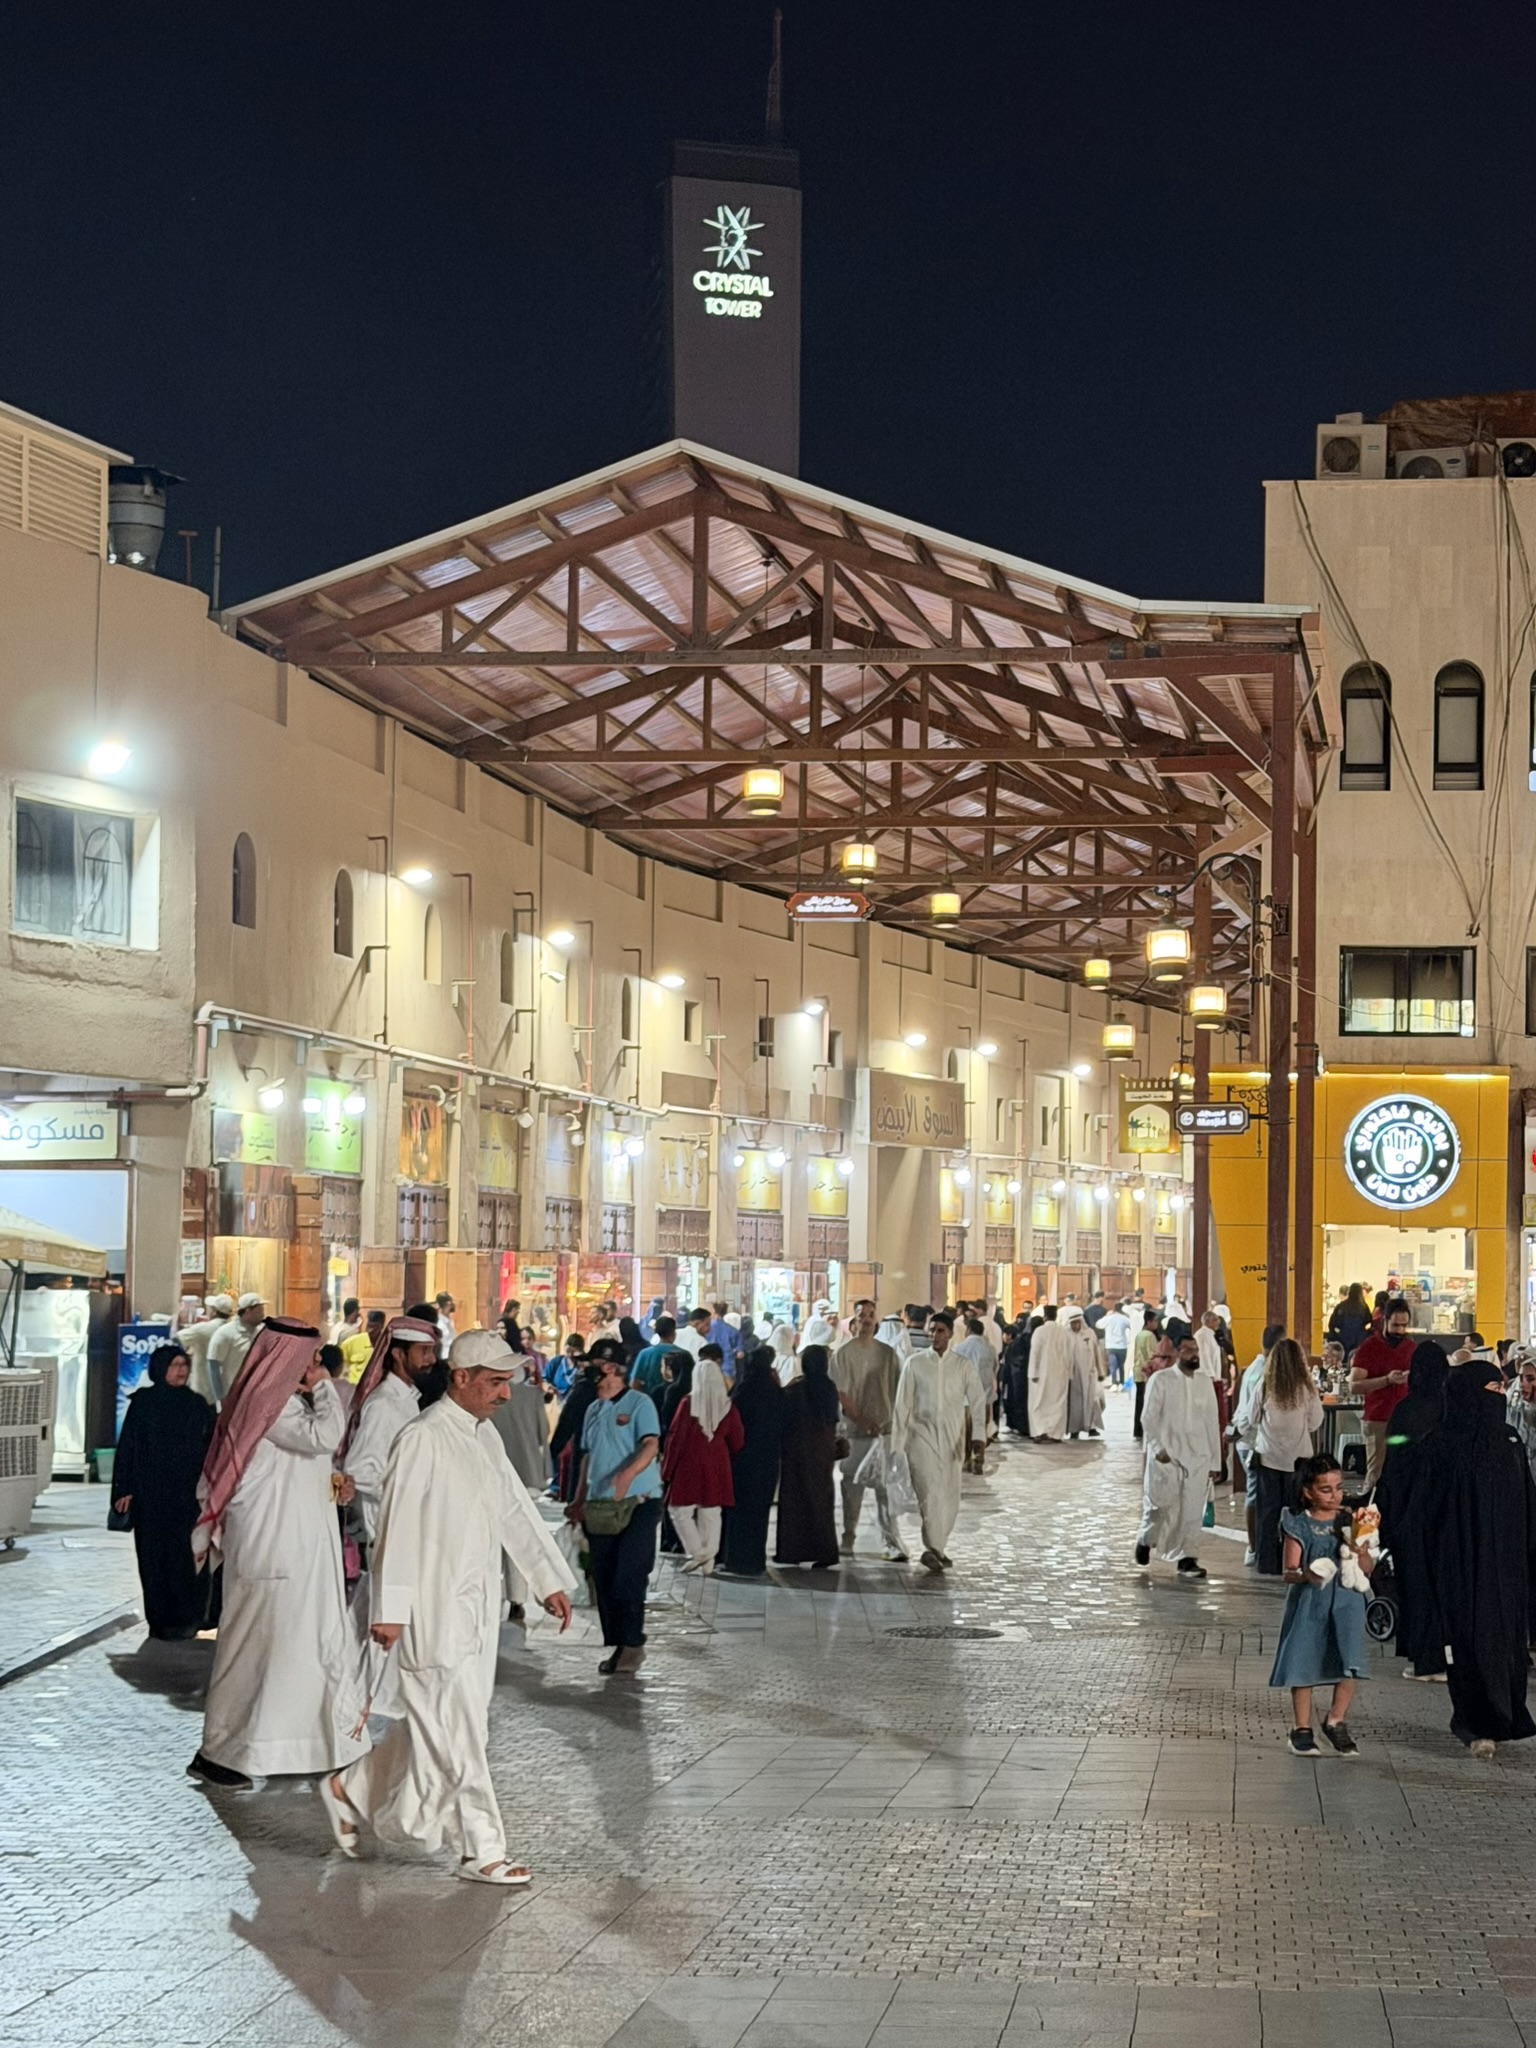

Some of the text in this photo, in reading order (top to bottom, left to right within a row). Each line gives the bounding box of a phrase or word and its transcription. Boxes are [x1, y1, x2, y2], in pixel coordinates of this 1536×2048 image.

[693, 270, 774, 297] CRYSTAL
[705, 297, 762, 318] TOWER
[923, 1096, 960, 1140] السوق
